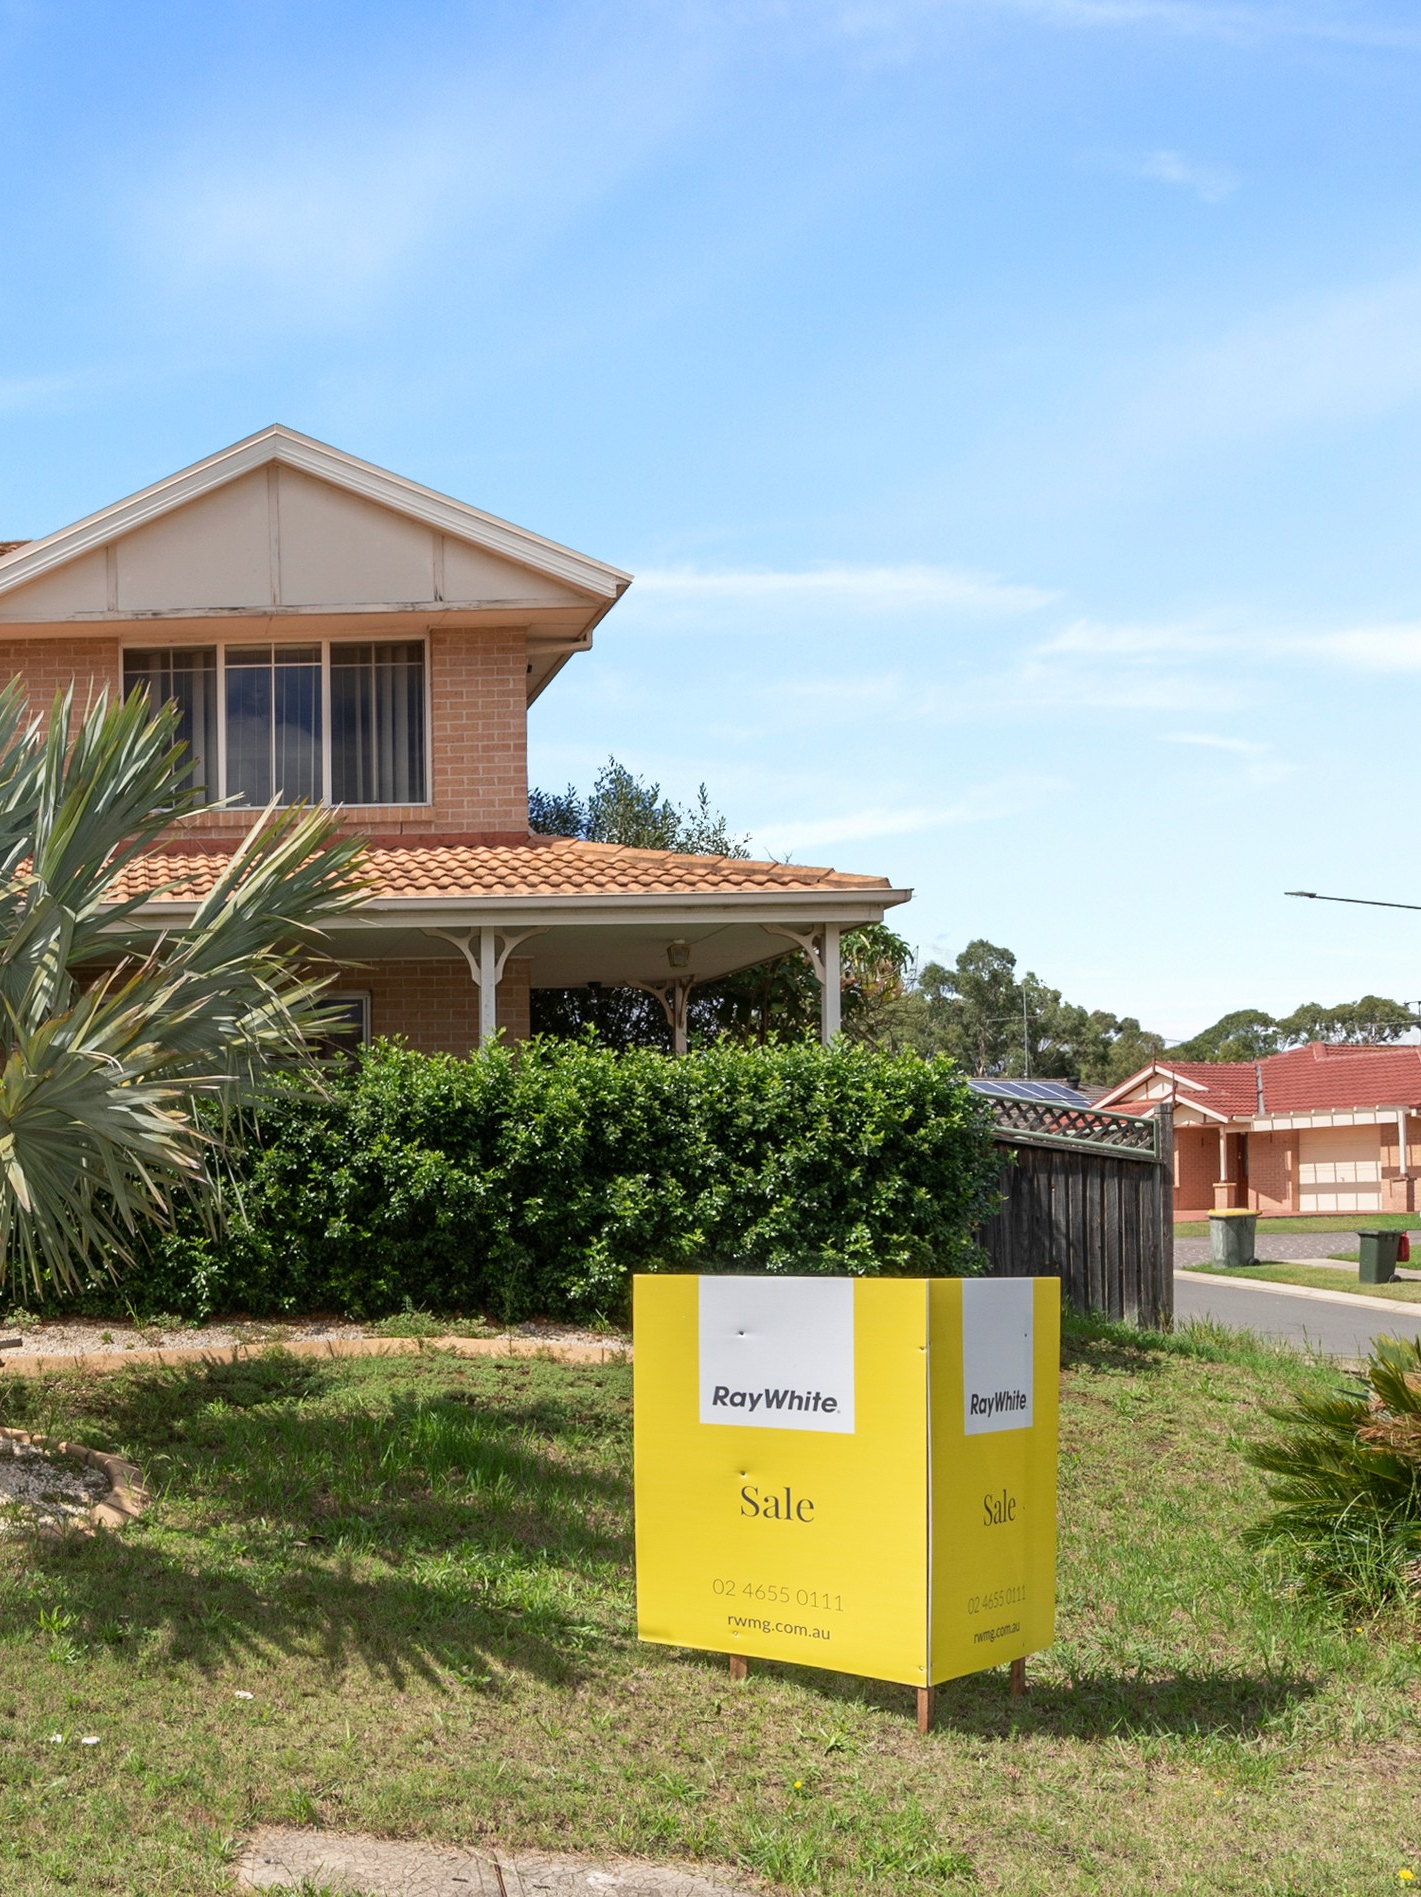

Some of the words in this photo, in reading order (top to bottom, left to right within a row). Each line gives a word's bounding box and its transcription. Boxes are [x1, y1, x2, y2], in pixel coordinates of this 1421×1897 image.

[712, 1386, 838, 1413] RayWhite
[970, 1390, 1027, 1418] RayWhite
[740, 1486, 815, 1522] Sale
[983, 1489, 1016, 1526] Sale
[712, 1578, 736, 1597] 02
[742, 1583, 790, 1603] 4655
[796, 1589, 844, 1612] 0111
[967, 1596, 981, 1615] 02
[982, 1590, 1005, 1610] 4655
[1006, 1585, 1026, 1605] 0111
[727, 1615, 831, 1640] rwmg.com.au
[973, 1621, 1021, 1644] rwmg.com.au
